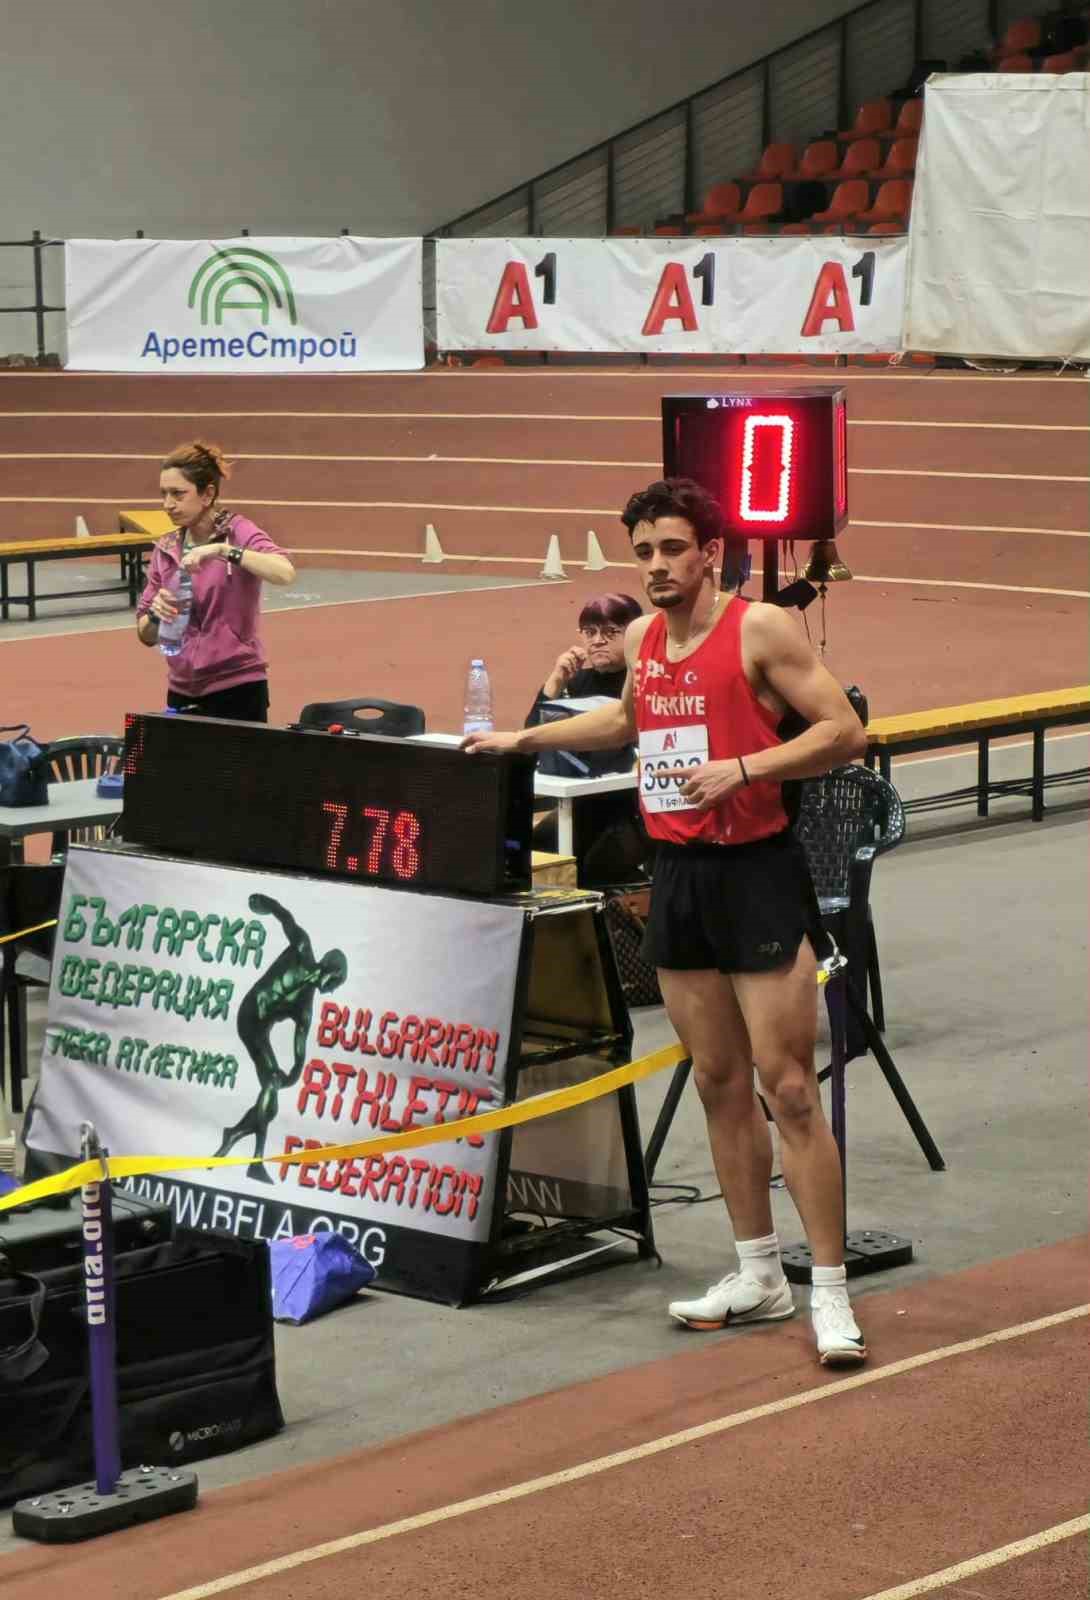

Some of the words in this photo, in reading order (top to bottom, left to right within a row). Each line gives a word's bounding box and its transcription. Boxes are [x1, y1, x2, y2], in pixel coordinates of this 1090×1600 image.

[486, 252, 557, 335] A1
[641, 252, 715, 336] A1
[801, 251, 876, 337] A1
[740, 415, 794, 521] 0
[322, 801, 421, 880] 7.78
[63, 894, 267, 969] БЪЛГАРСКА
[58, 954, 234, 1022] ФЕДЕРАЦИЯ
[115, 1036, 239, 1090] АТЛЕТИКА
[317, 1001, 500, 1075] BULGARIAN
[278, 1135, 483, 1221] FEDERATION
